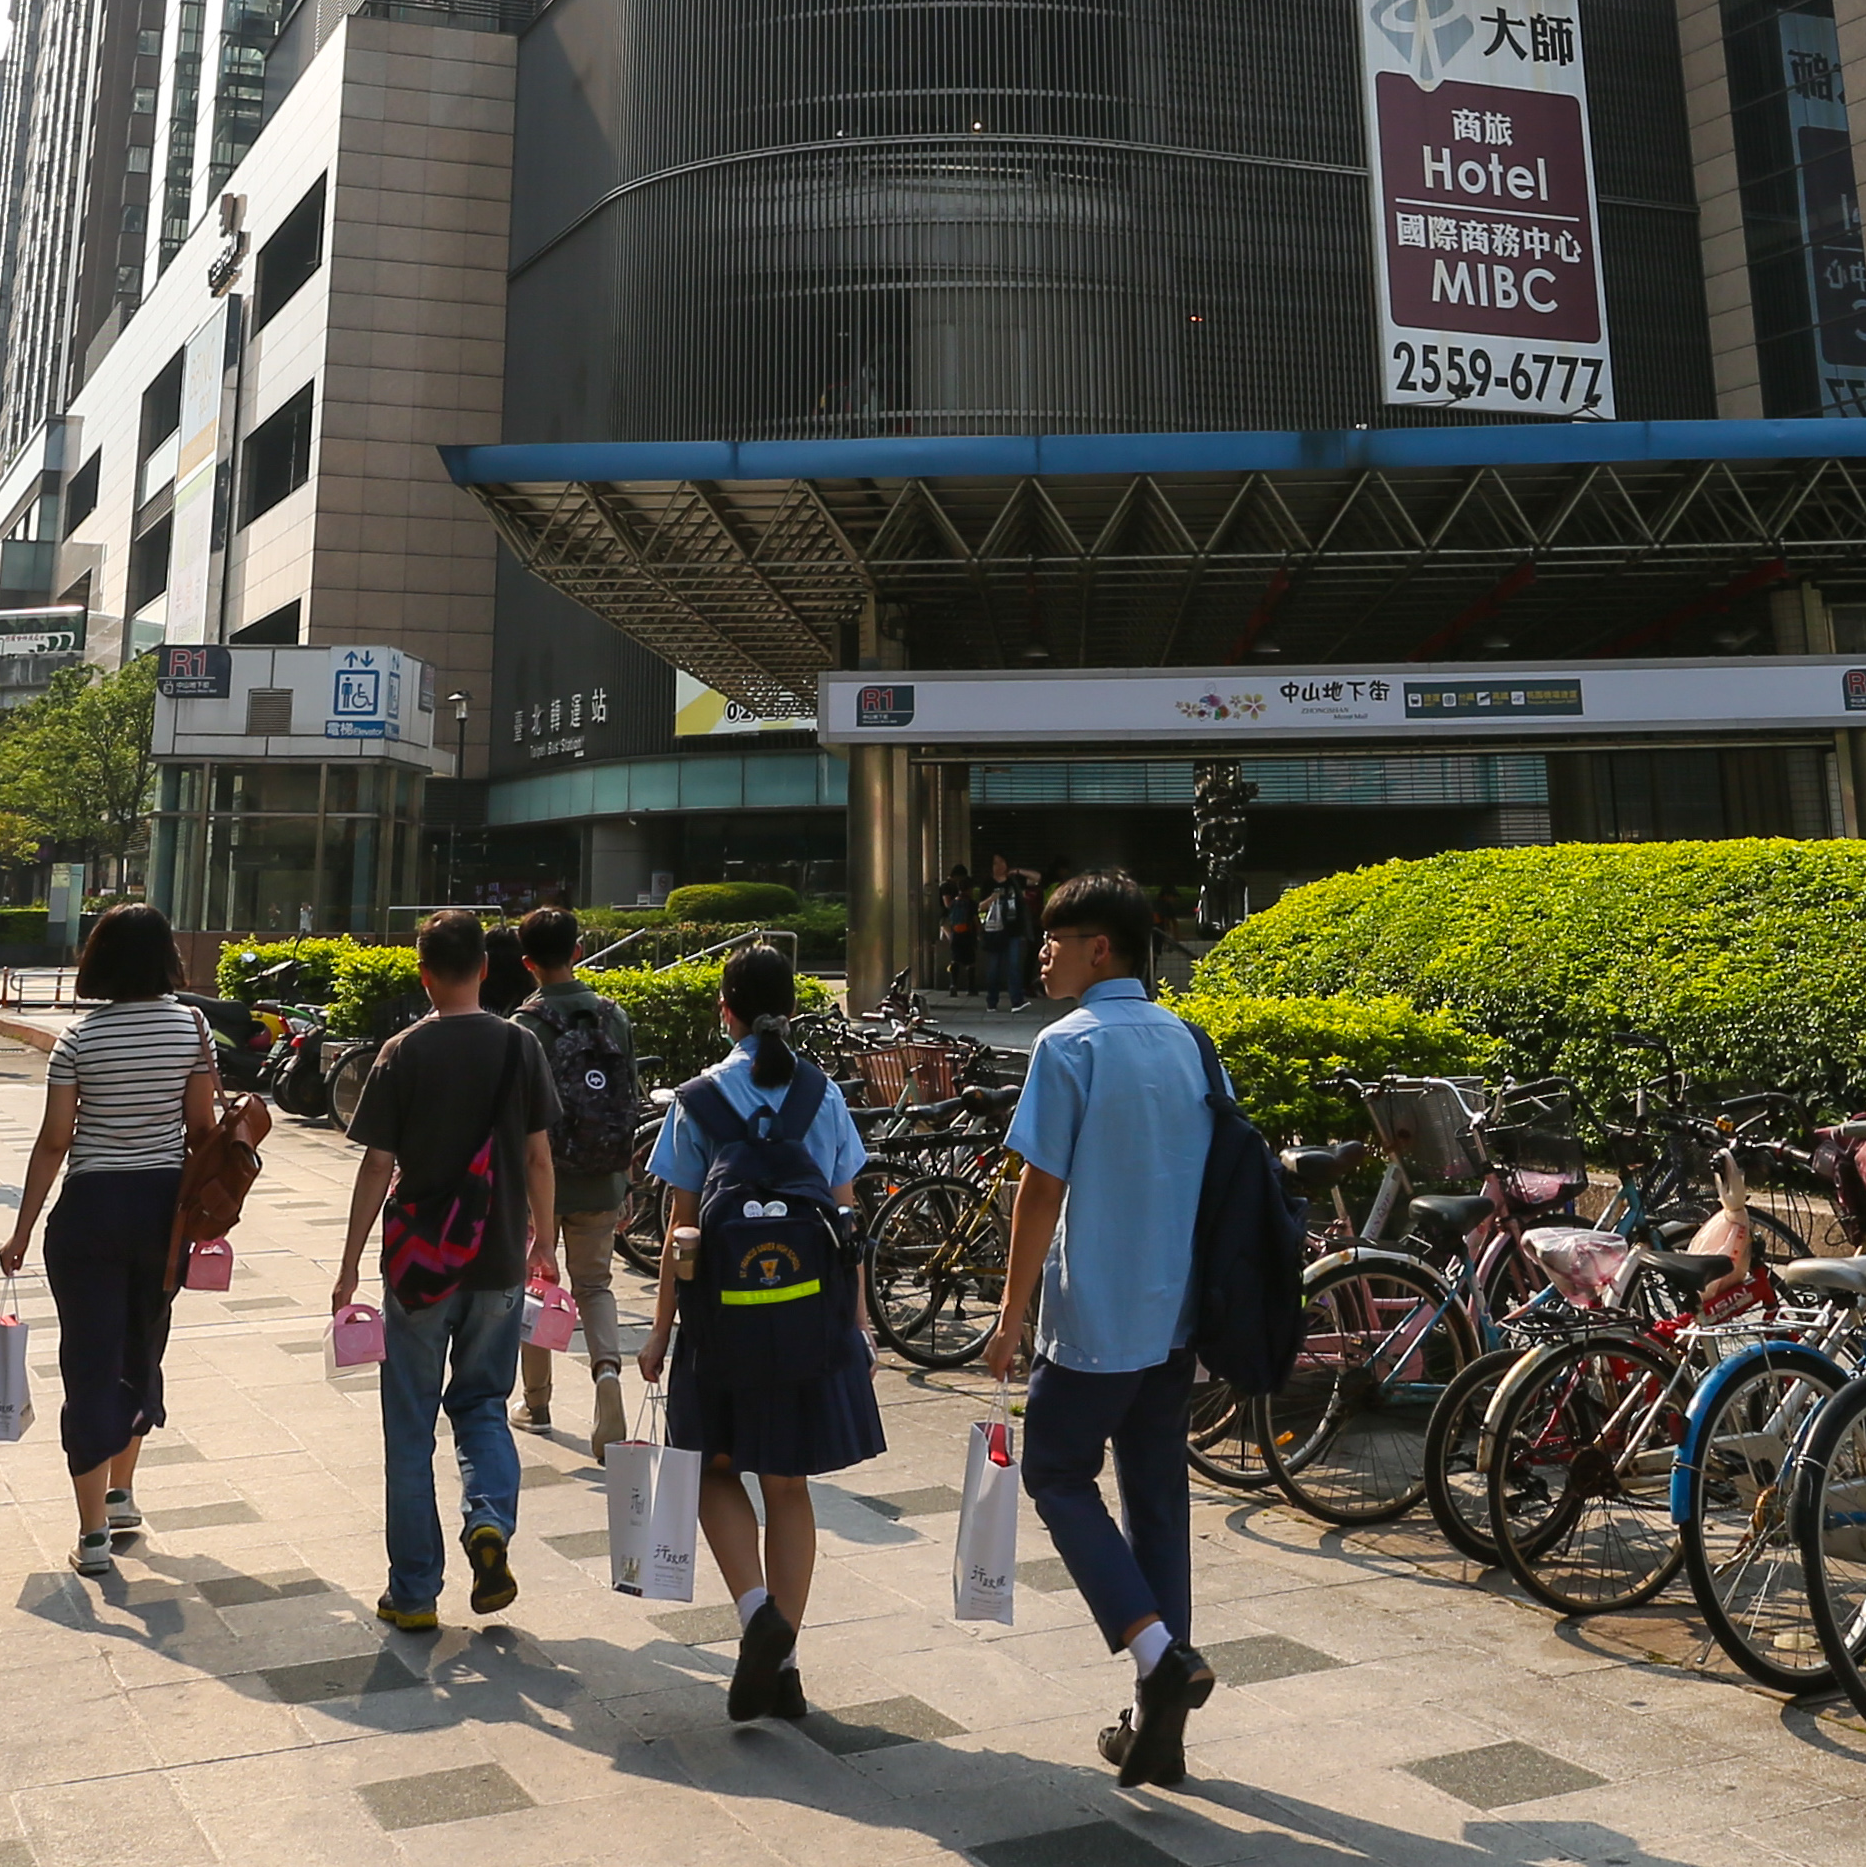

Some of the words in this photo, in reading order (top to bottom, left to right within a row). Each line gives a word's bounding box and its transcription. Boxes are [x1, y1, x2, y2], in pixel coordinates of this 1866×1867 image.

[1480, 6, 1575, 67] 大師
[1451, 108, 1514, 147] 商旅
[1422, 144, 1549, 202] Hotel
[1395, 211, 1582, 264] 國際商務中心
[1431, 258, 1559, 314] MIBC
[1393, 341, 1604, 404] 2559-6777
[168, 648, 207, 678] R1
[861, 687, 893, 712] R1
[1279, 679, 1391, 704] 中山地下街
